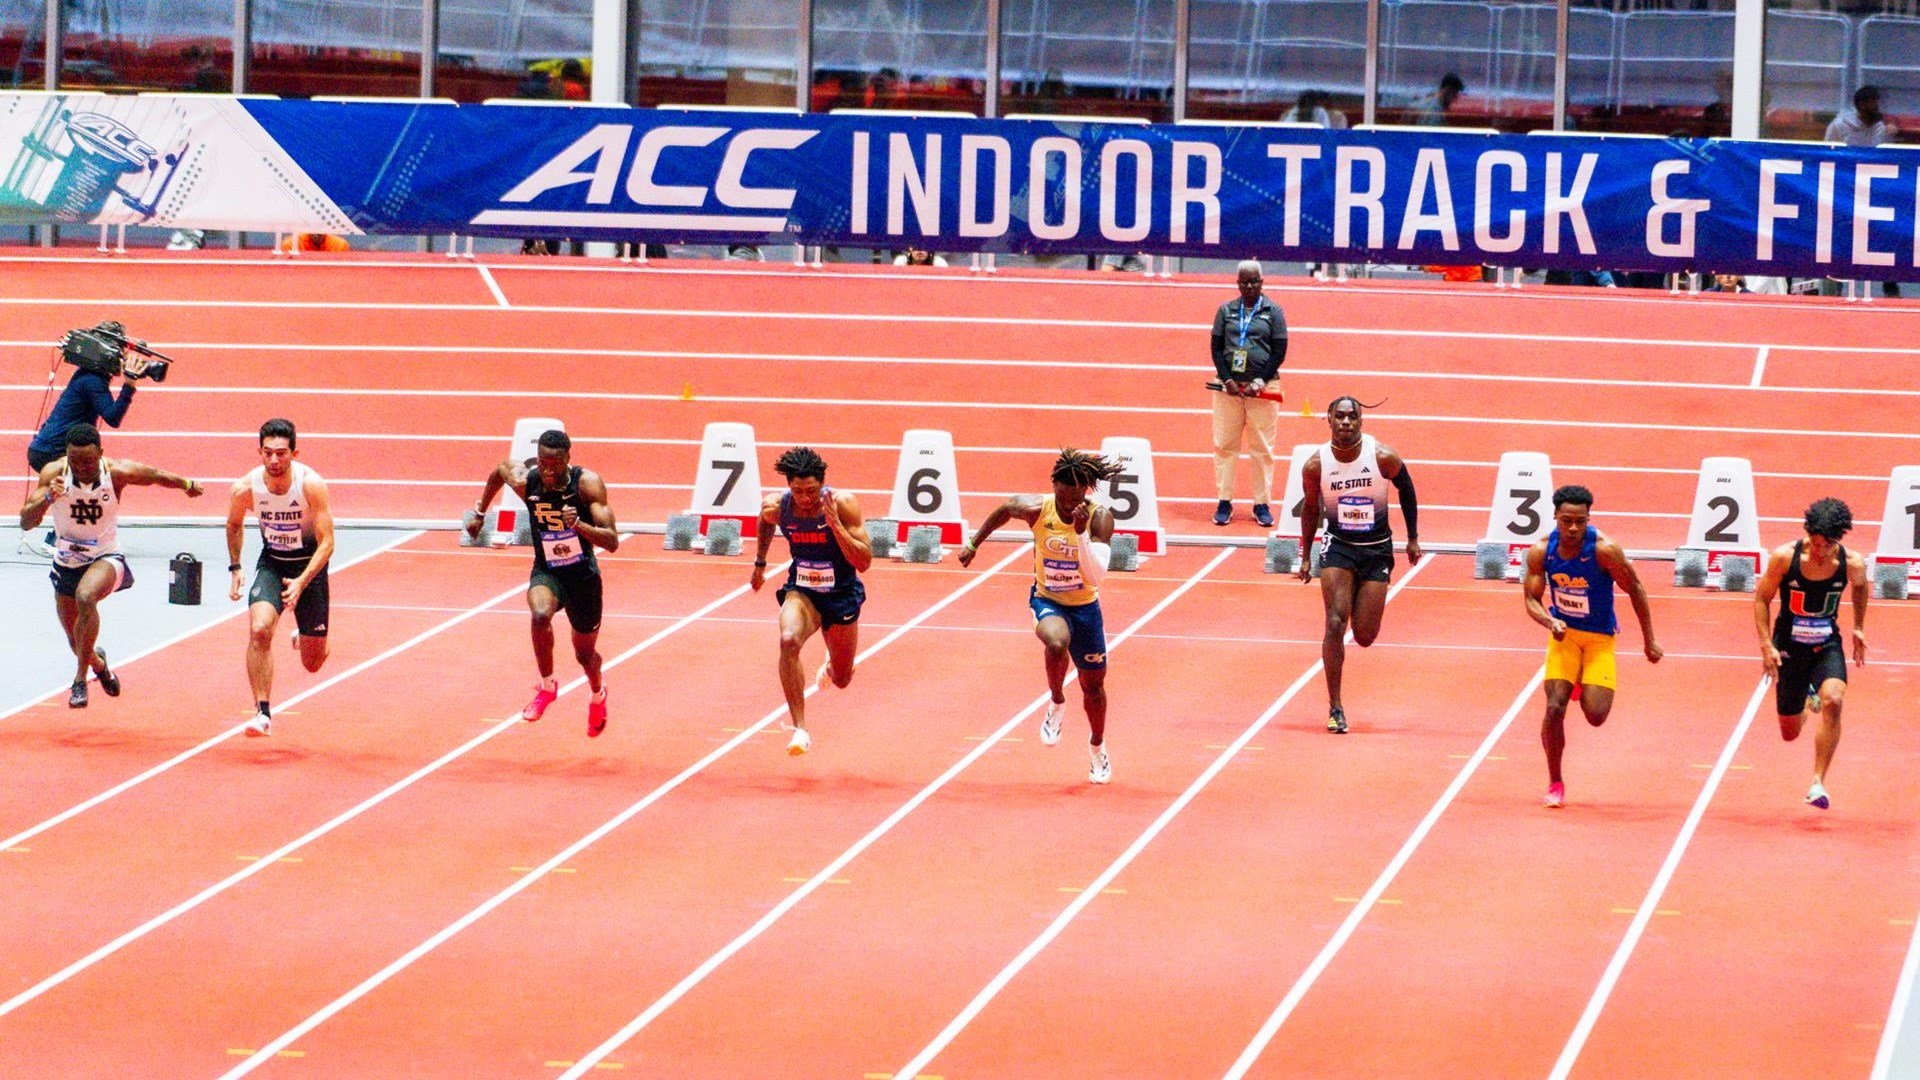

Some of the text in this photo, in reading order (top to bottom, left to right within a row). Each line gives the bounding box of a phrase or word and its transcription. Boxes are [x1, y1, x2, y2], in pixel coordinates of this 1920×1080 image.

[502, 125, 1920, 267] ACC INDOOR TRACK & FIE
[711, 460, 746, 507] 7
[907, 467, 943, 514] 6
[1109, 474, 1140, 521] 5
[1330, 478, 1373, 491] NC STATE
[261, 510, 303, 521] NC STATE
[1506, 489, 1541, 536] 3
[1705, 495, 1740, 543] 2
[1905, 503, 1920, 550] 1
[269, 534, 298, 545] EPSTEIN
[1045, 536, 1078, 559] GT
[1551, 573, 1590, 589] Pitt
[1789, 590, 1841, 617] U
